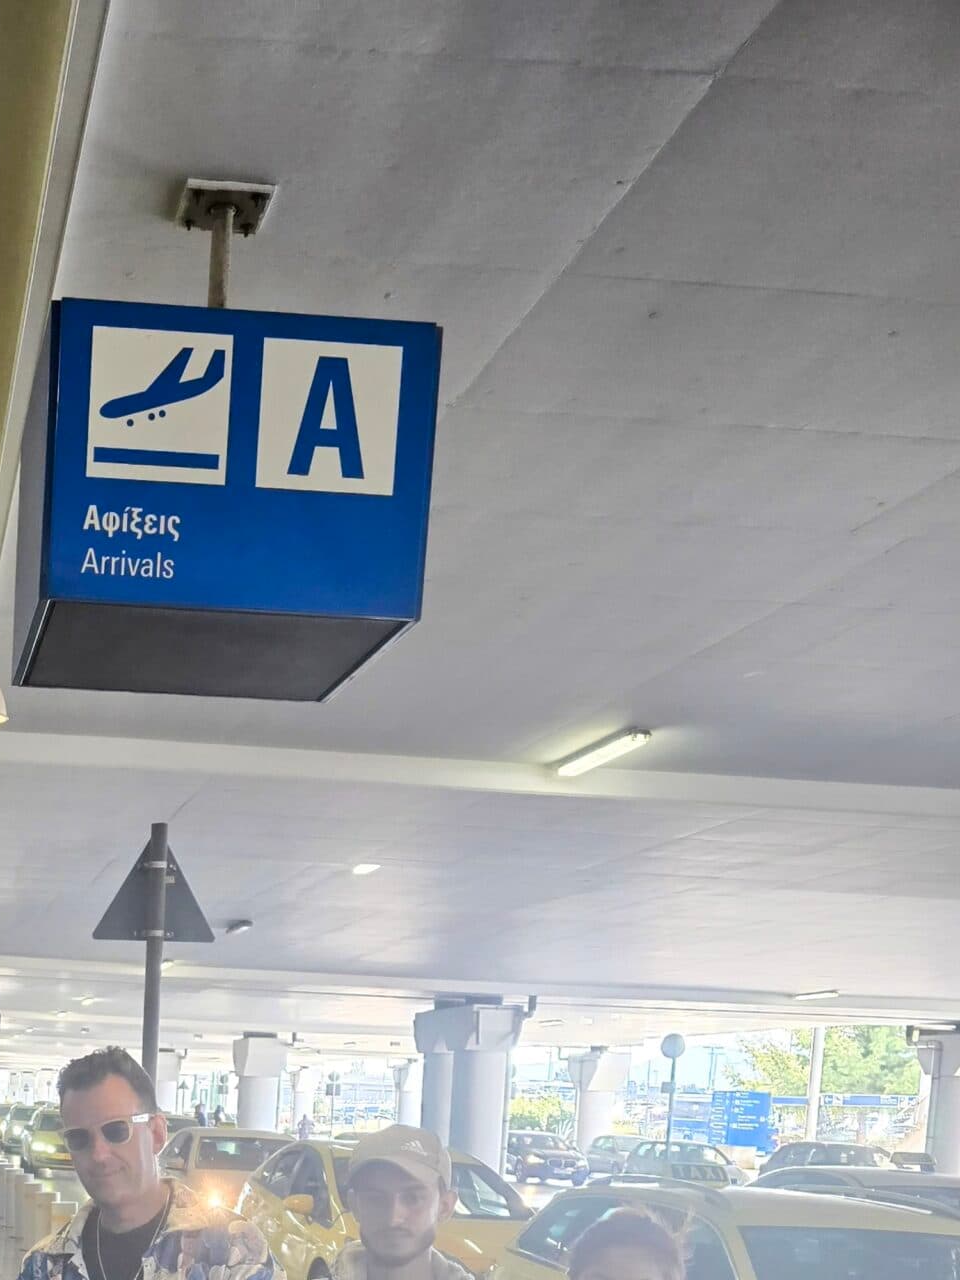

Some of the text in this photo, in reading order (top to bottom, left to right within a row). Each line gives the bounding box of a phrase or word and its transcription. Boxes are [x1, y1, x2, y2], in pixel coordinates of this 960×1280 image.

[286, 355, 365, 480] A
[82, 504, 181, 541] Αφίξεις
[80, 546, 175, 580] Arrivals
